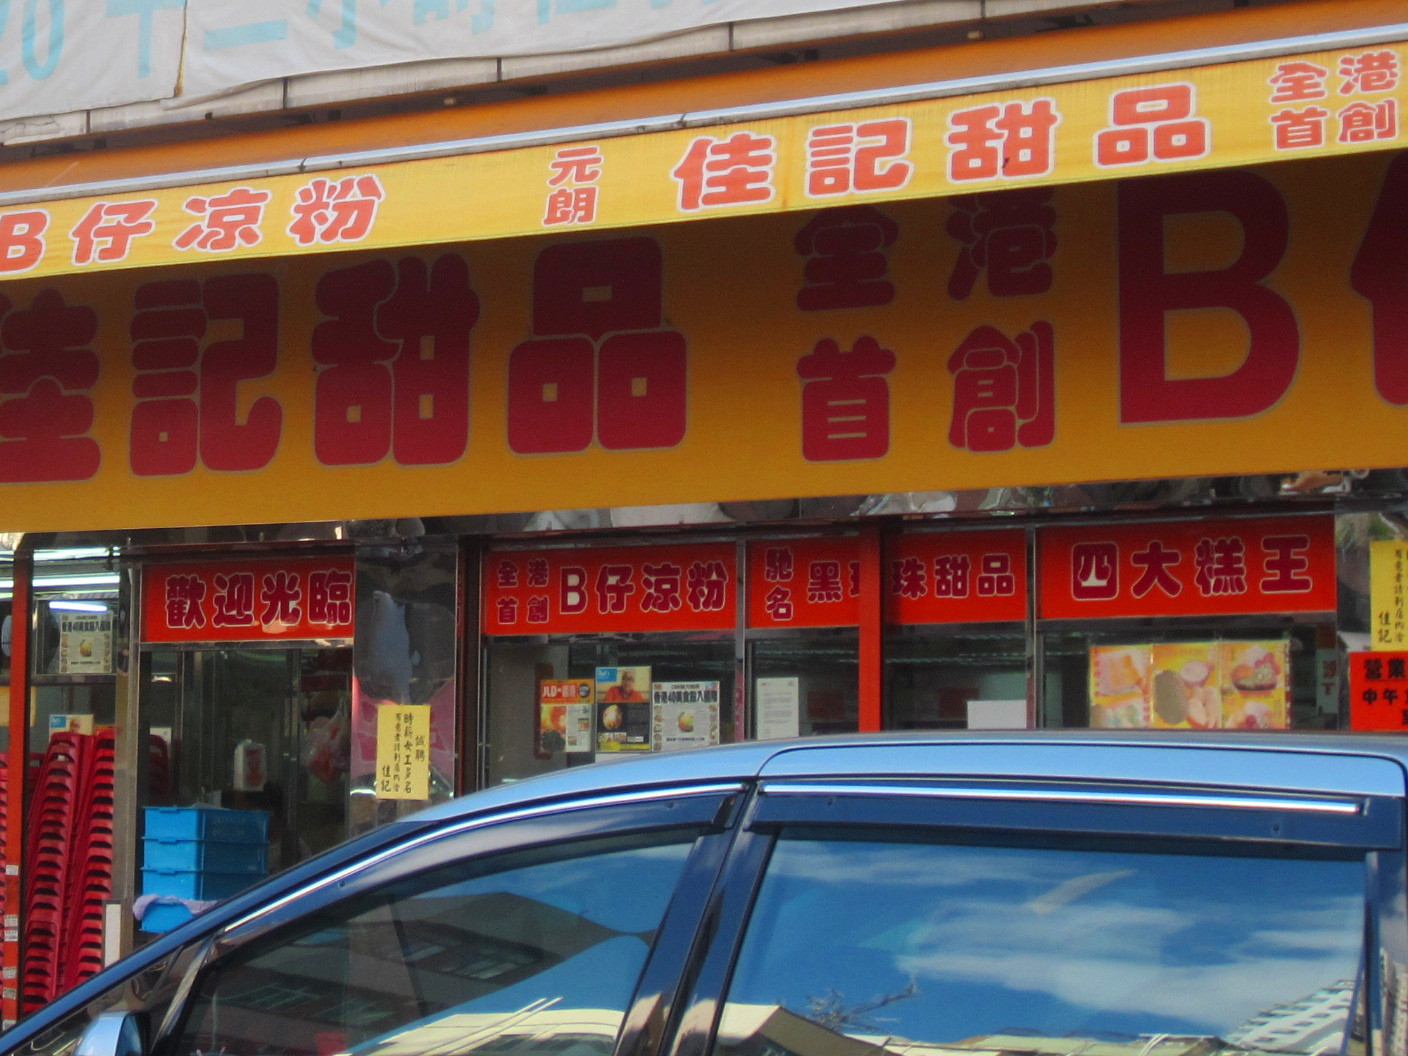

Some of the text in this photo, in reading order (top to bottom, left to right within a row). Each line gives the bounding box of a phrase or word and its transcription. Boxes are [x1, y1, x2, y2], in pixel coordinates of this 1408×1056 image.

[1269, 51, 1400, 103] 全港
[673, 82, 1211, 214] 佳記甜品
[1272, 98, 1399, 151] 首創
[541, 144, 603, 227] 元朗
[795, 194, 1057, 313] 全港
[795, 319, 1056, 462] 首創
[164, 568, 353, 631] 歡迎光臨
[496, 558, 730, 626] 全港 首創 B仔涼粉
[764, 546, 795, 622] 馳名
[1070, 534, 1315, 601] 四大糕王
[1378, 611, 1393, 644] 佳記
[1362, 688, 1408, 706] 中午
